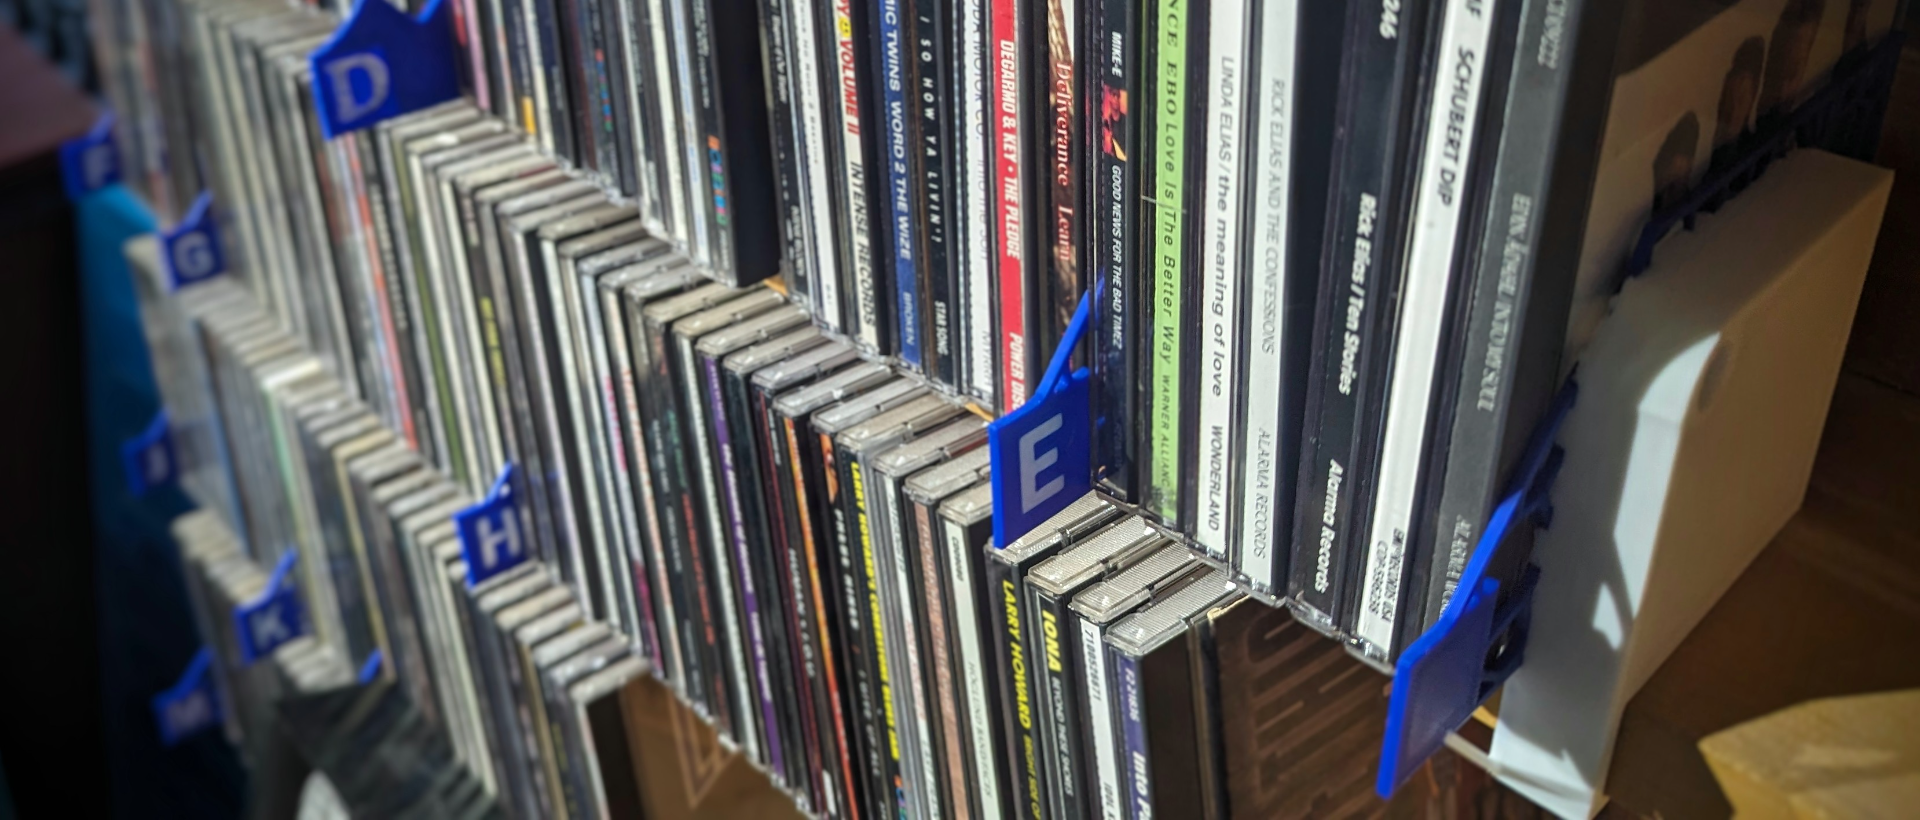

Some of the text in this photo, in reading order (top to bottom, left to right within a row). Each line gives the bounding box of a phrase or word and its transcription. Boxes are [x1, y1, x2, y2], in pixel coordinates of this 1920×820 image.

[887, 30, 900, 92] TWINS
[920, 38, 932, 62] SO
[1111, 31, 1123, 78] MIKE-E
[324, 52, 391, 124] D
[839, 40, 859, 120] VOLUME
[922, 77, 935, 121] HOW
[1166, 62, 1177, 115] EBO
[1220, 56, 1234, 108] LINDA
[1443, 45, 1475, 165] SCHUBERT
[847, 122, 860, 136] II
[925, 135, 938, 157] YA
[1000, 39, 1021, 261] DEGARMO & KEY THE PLEDGE
[1165, 122, 1177, 173] Love
[1218, 112, 1233, 162] ELIAS
[890, 101, 912, 260] WORD 2 THE WIZE
[1057, 62, 1073, 261] Deliverance Learn
[1437, 165, 1457, 207] DIP
[1164, 181, 1177, 200] Is
[1217, 174, 1231, 212] the
[1261, 78, 1285, 356] RICK ELIAS AND THE CONFESSIONS
[1356, 192, 1377, 237] Rick
[173, 230, 215, 280] G
[850, 161, 876, 326] INTENSE RECORDS
[1163, 210, 1176, 246] The
[1111, 165, 1123, 350] GOOD NEWS FOR THE BAD TIMEZ
[1211, 218, 1228, 318] meaning
[1351, 237, 1372, 286] Elias
[1163, 255, 1176, 317] Better
[902, 291, 915, 346] BROKEN
[934, 300, 949, 356] STAR SONG
[1213, 322, 1226, 347] of
[1345, 296, 1365, 333] Ten
[1009, 332, 1025, 380] POWER
[1160, 326, 1175, 364] Way
[1338, 331, 1360, 396] Stories
[1211, 349, 1225, 397] love
[1160, 374, 1171, 429] WARNER
[851, 461, 866, 511] LARRY
[1018, 412, 1065, 515] E
[1208, 425, 1223, 532] WONDERLAND
[1253, 427, 1271, 560] ALARMA RECORDS
[475, 507, 520, 569] H
[1314, 458, 1344, 594] Alarma Records
[249, 604, 290, 641] K
[1002, 579, 1021, 641] LARRY
[1010, 642, 1032, 730] HOWARD
[1042, 609, 1074, 797] IONA BEYOND THESE SHORES
[1132, 750, 1148, 797] Into
